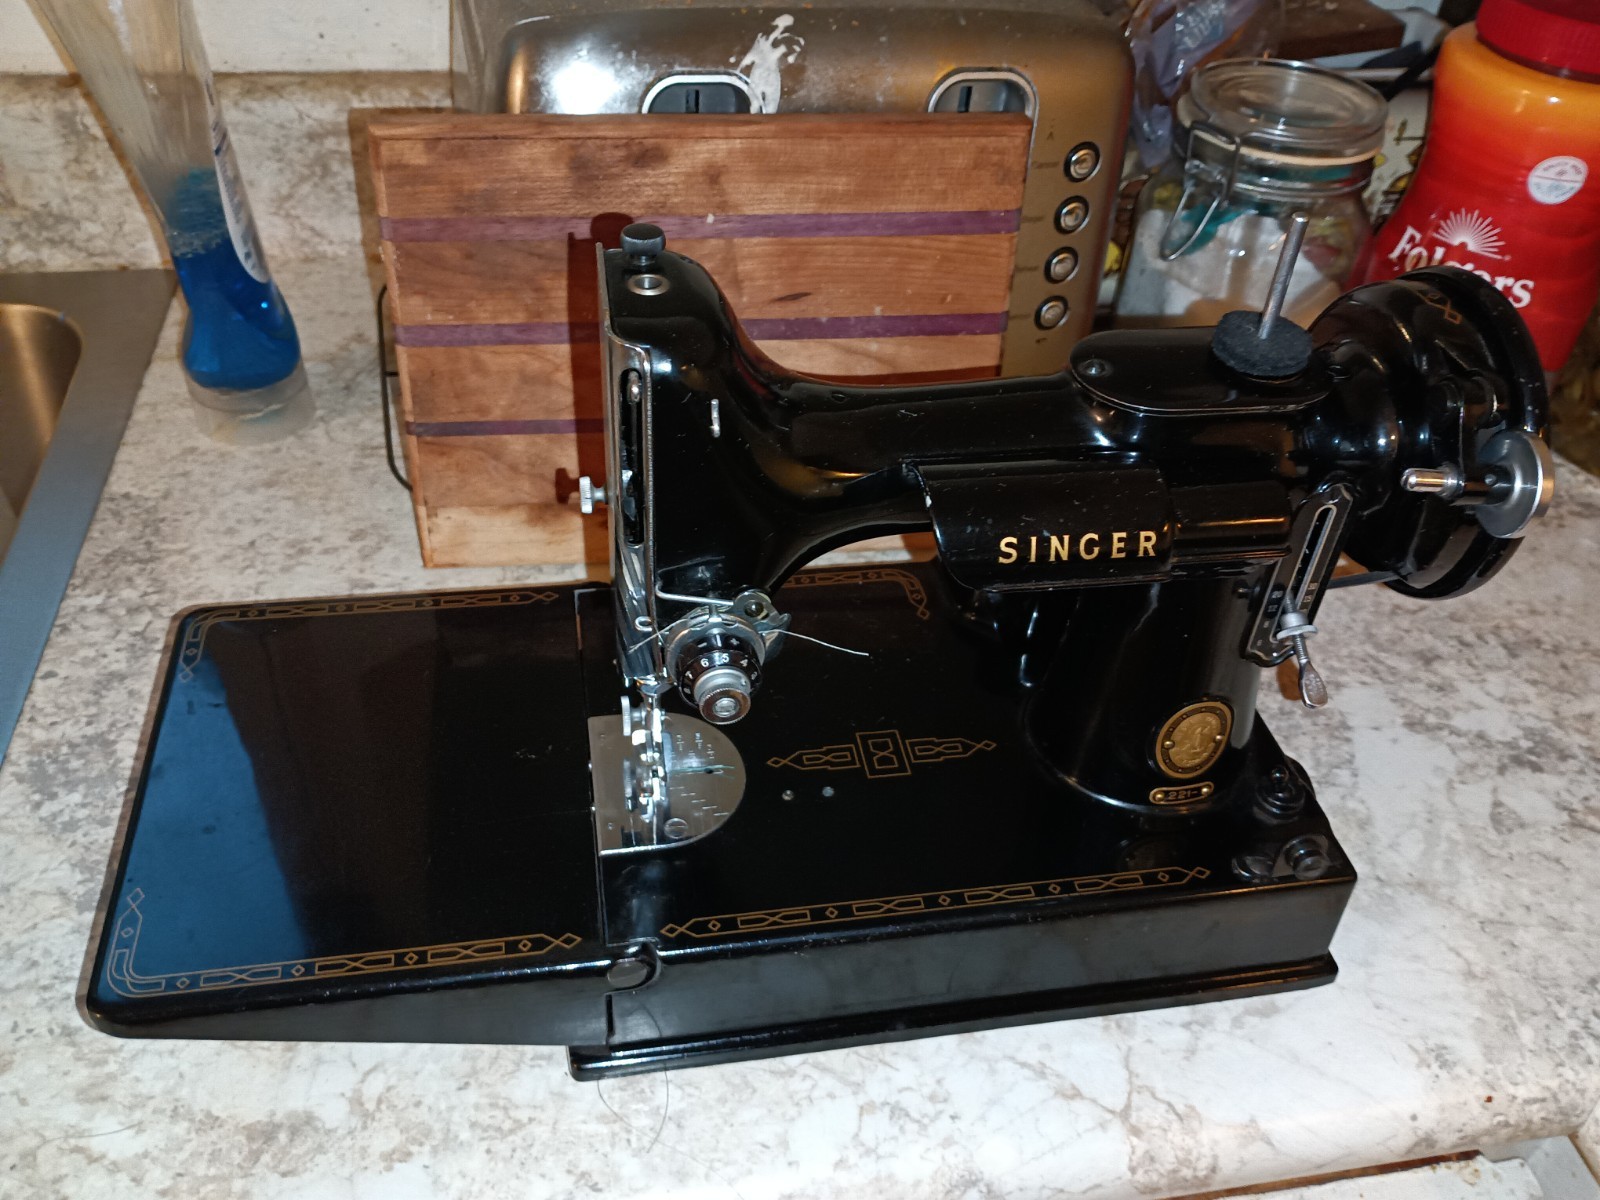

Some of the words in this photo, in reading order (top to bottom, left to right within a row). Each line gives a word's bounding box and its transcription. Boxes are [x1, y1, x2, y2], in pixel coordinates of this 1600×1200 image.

[1388, 225, 1535, 308] Folrs
[998, 530, 1157, 564] SINGER
[700, 658, 709, 668] 6
[721, 653, 730, 663] 5
